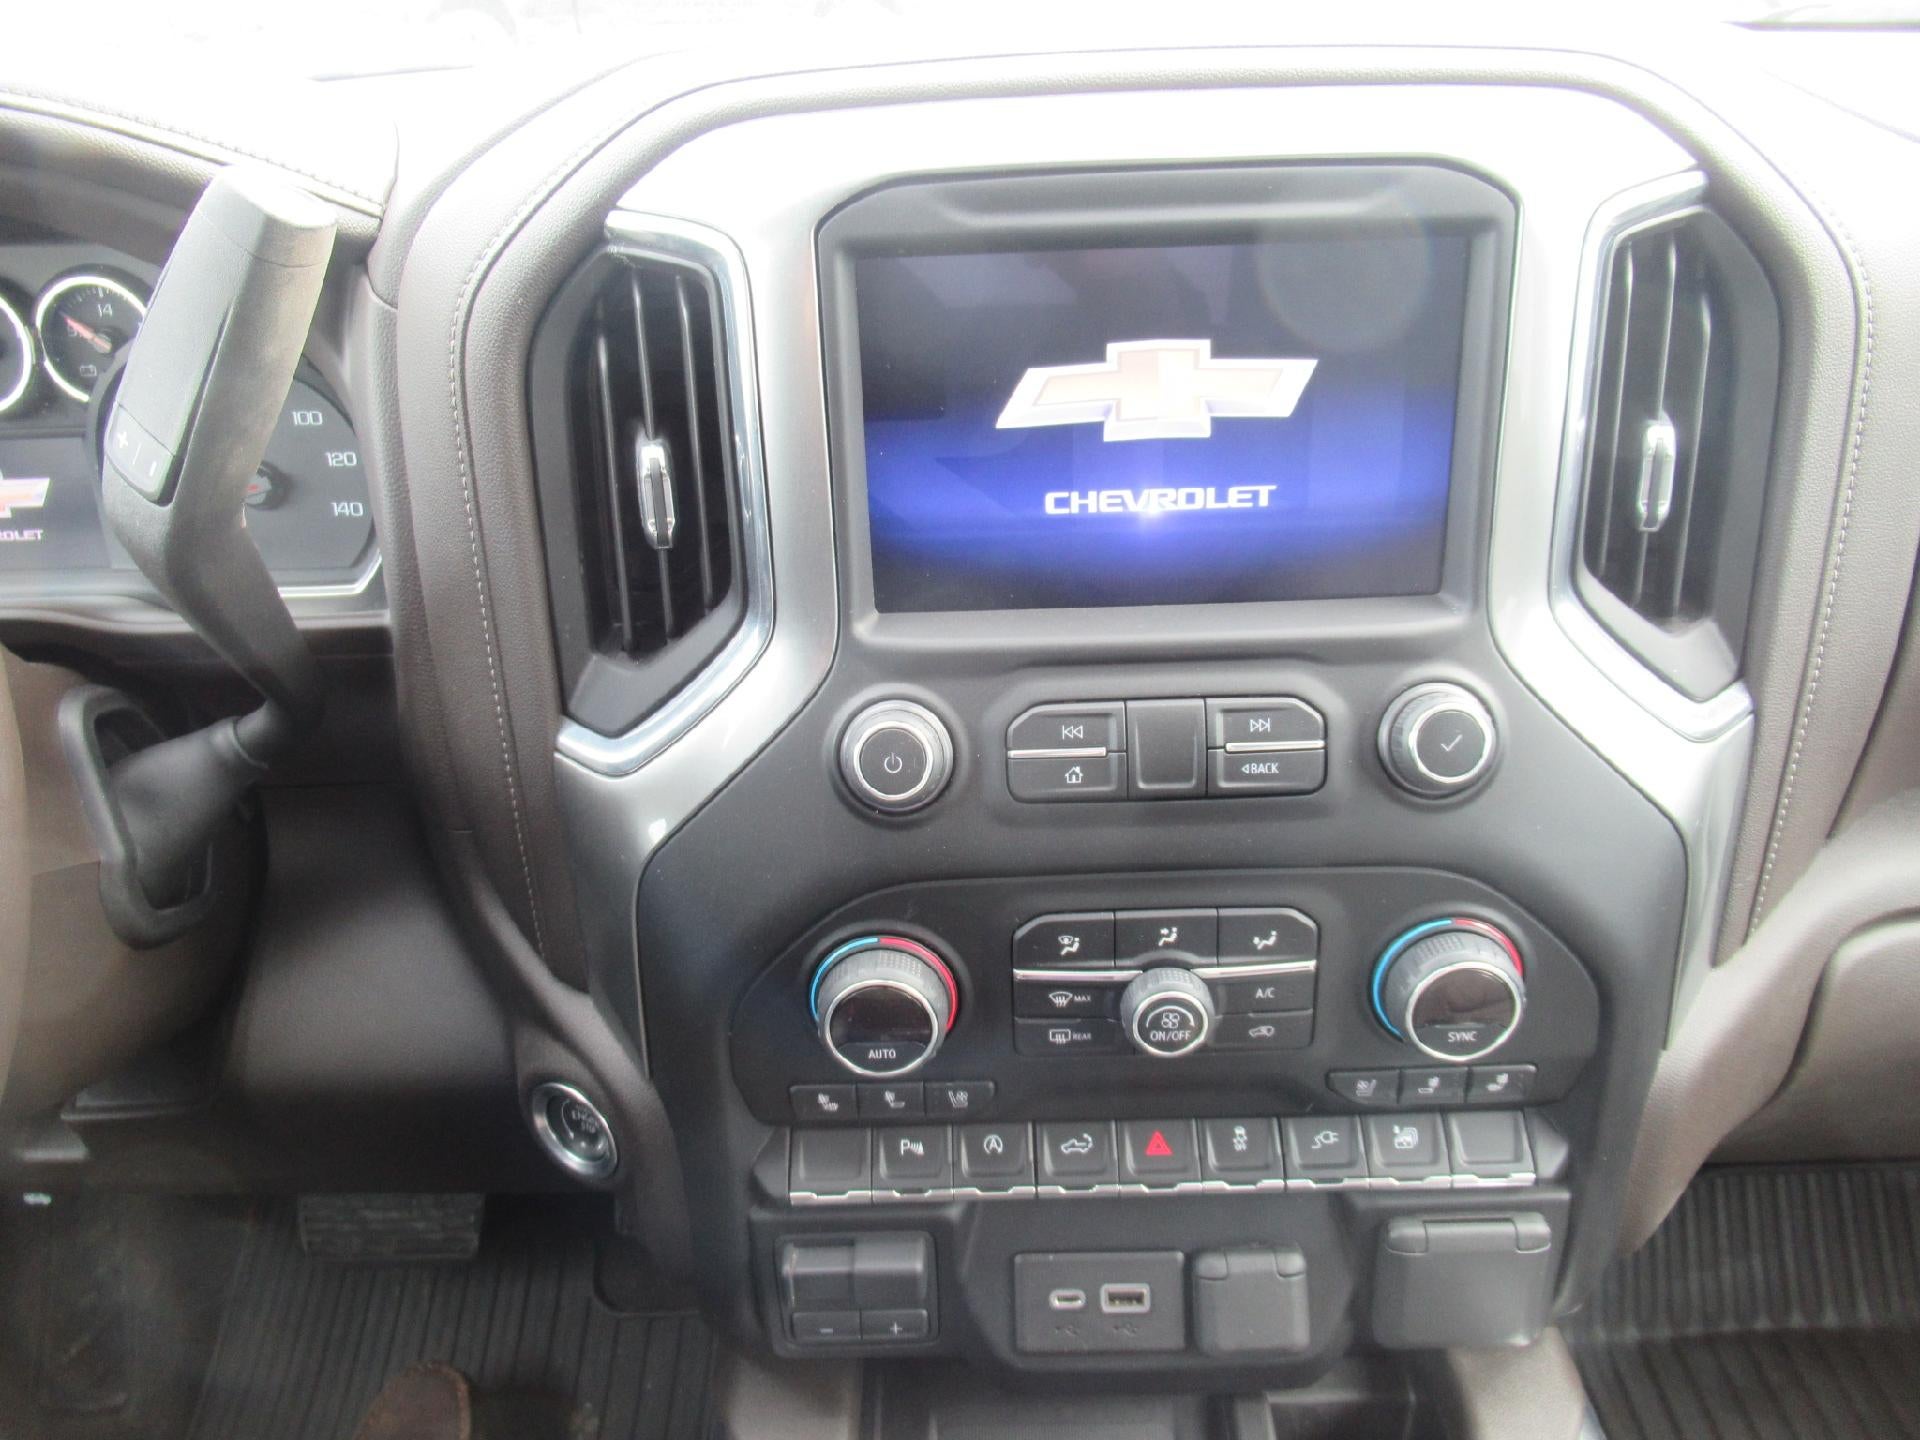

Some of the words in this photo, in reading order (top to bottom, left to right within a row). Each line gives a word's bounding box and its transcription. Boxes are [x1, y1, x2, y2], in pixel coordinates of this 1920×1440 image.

[97, 303, 113, 317] 14
[292, 411, 323, 426] 100
[325, 451, 357, 467] 120
[1045, 485, 1277, 514] CHEVROLET
[331, 502, 364, 517] 140
[1251, 762, 1279, 774] BACK
[1073, 994, 1091, 1002] MAX
[1255, 987, 1275, 999] A/C
[1150, 1030, 1191, 1041] ON/OFF
[1448, 1030, 1478, 1042] SYNC
[868, 1048, 896, 1060] AUTO
